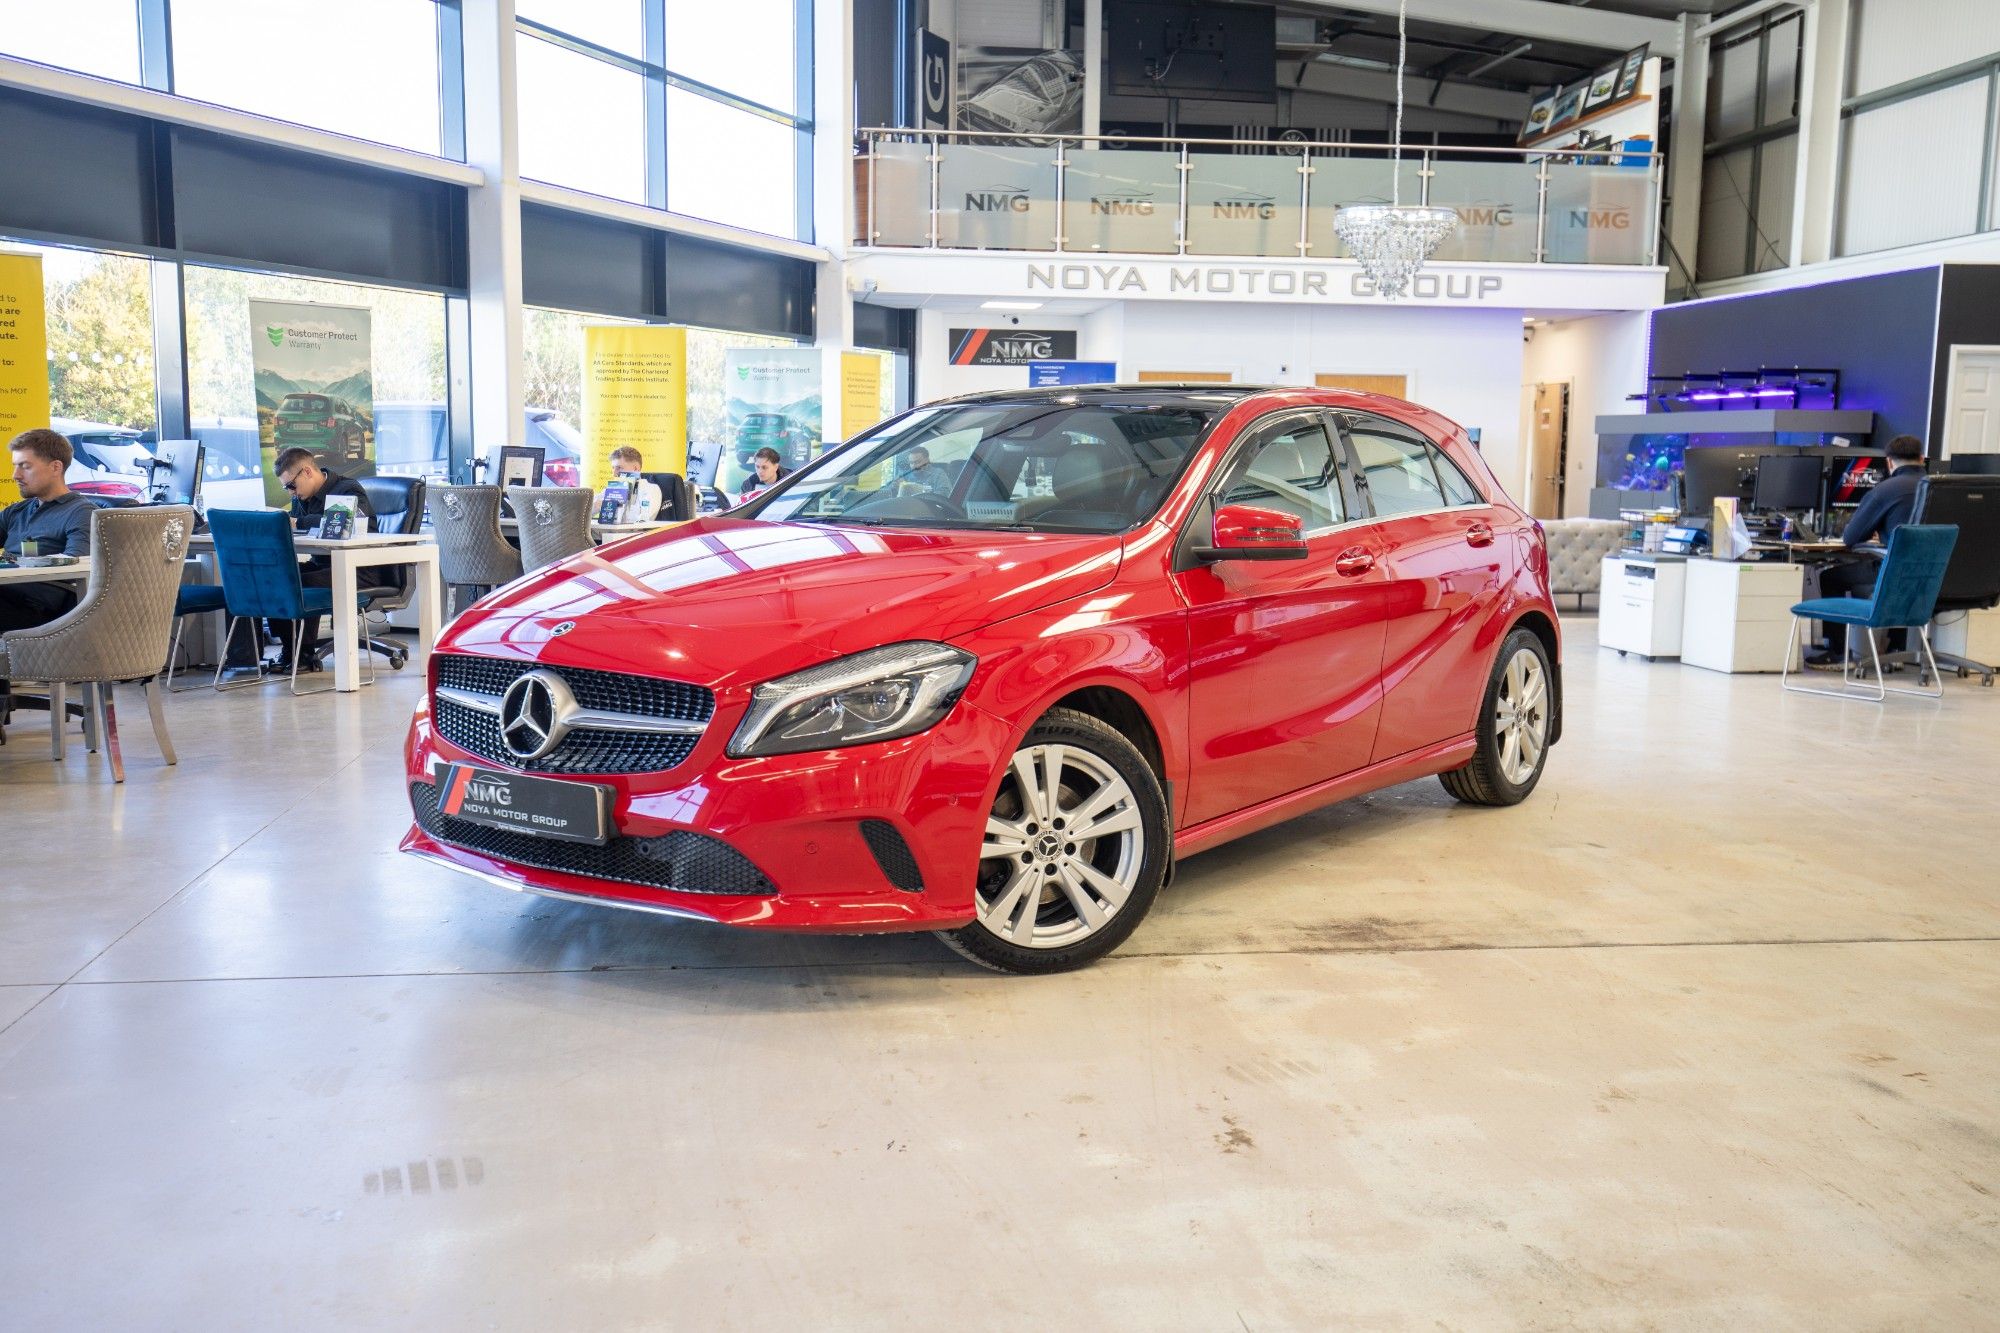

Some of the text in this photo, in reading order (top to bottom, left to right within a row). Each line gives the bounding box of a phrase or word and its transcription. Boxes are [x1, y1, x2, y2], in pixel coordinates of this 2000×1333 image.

[965, 193, 1030, 213] NMG
[1090, 197, 1155, 216] NMG
[1213, 201, 1277, 220] NMG
[1569, 211, 1630, 229] NMG
[1027, 264, 1147, 291] NOYA
[1170, 267, 1328, 296] MOTOR
[7, 294, 17, 302] to
[288, 328, 358, 341] Customer Protect
[289, 340, 322, 350] Warranty
[990, 340, 1053, 359] NMG
[463, 780, 512, 806] NMG
[464, 803, 490, 815] NOYA
[493, 808, 528, 822] MOTOR
[531, 814, 568, 828] GROUP
